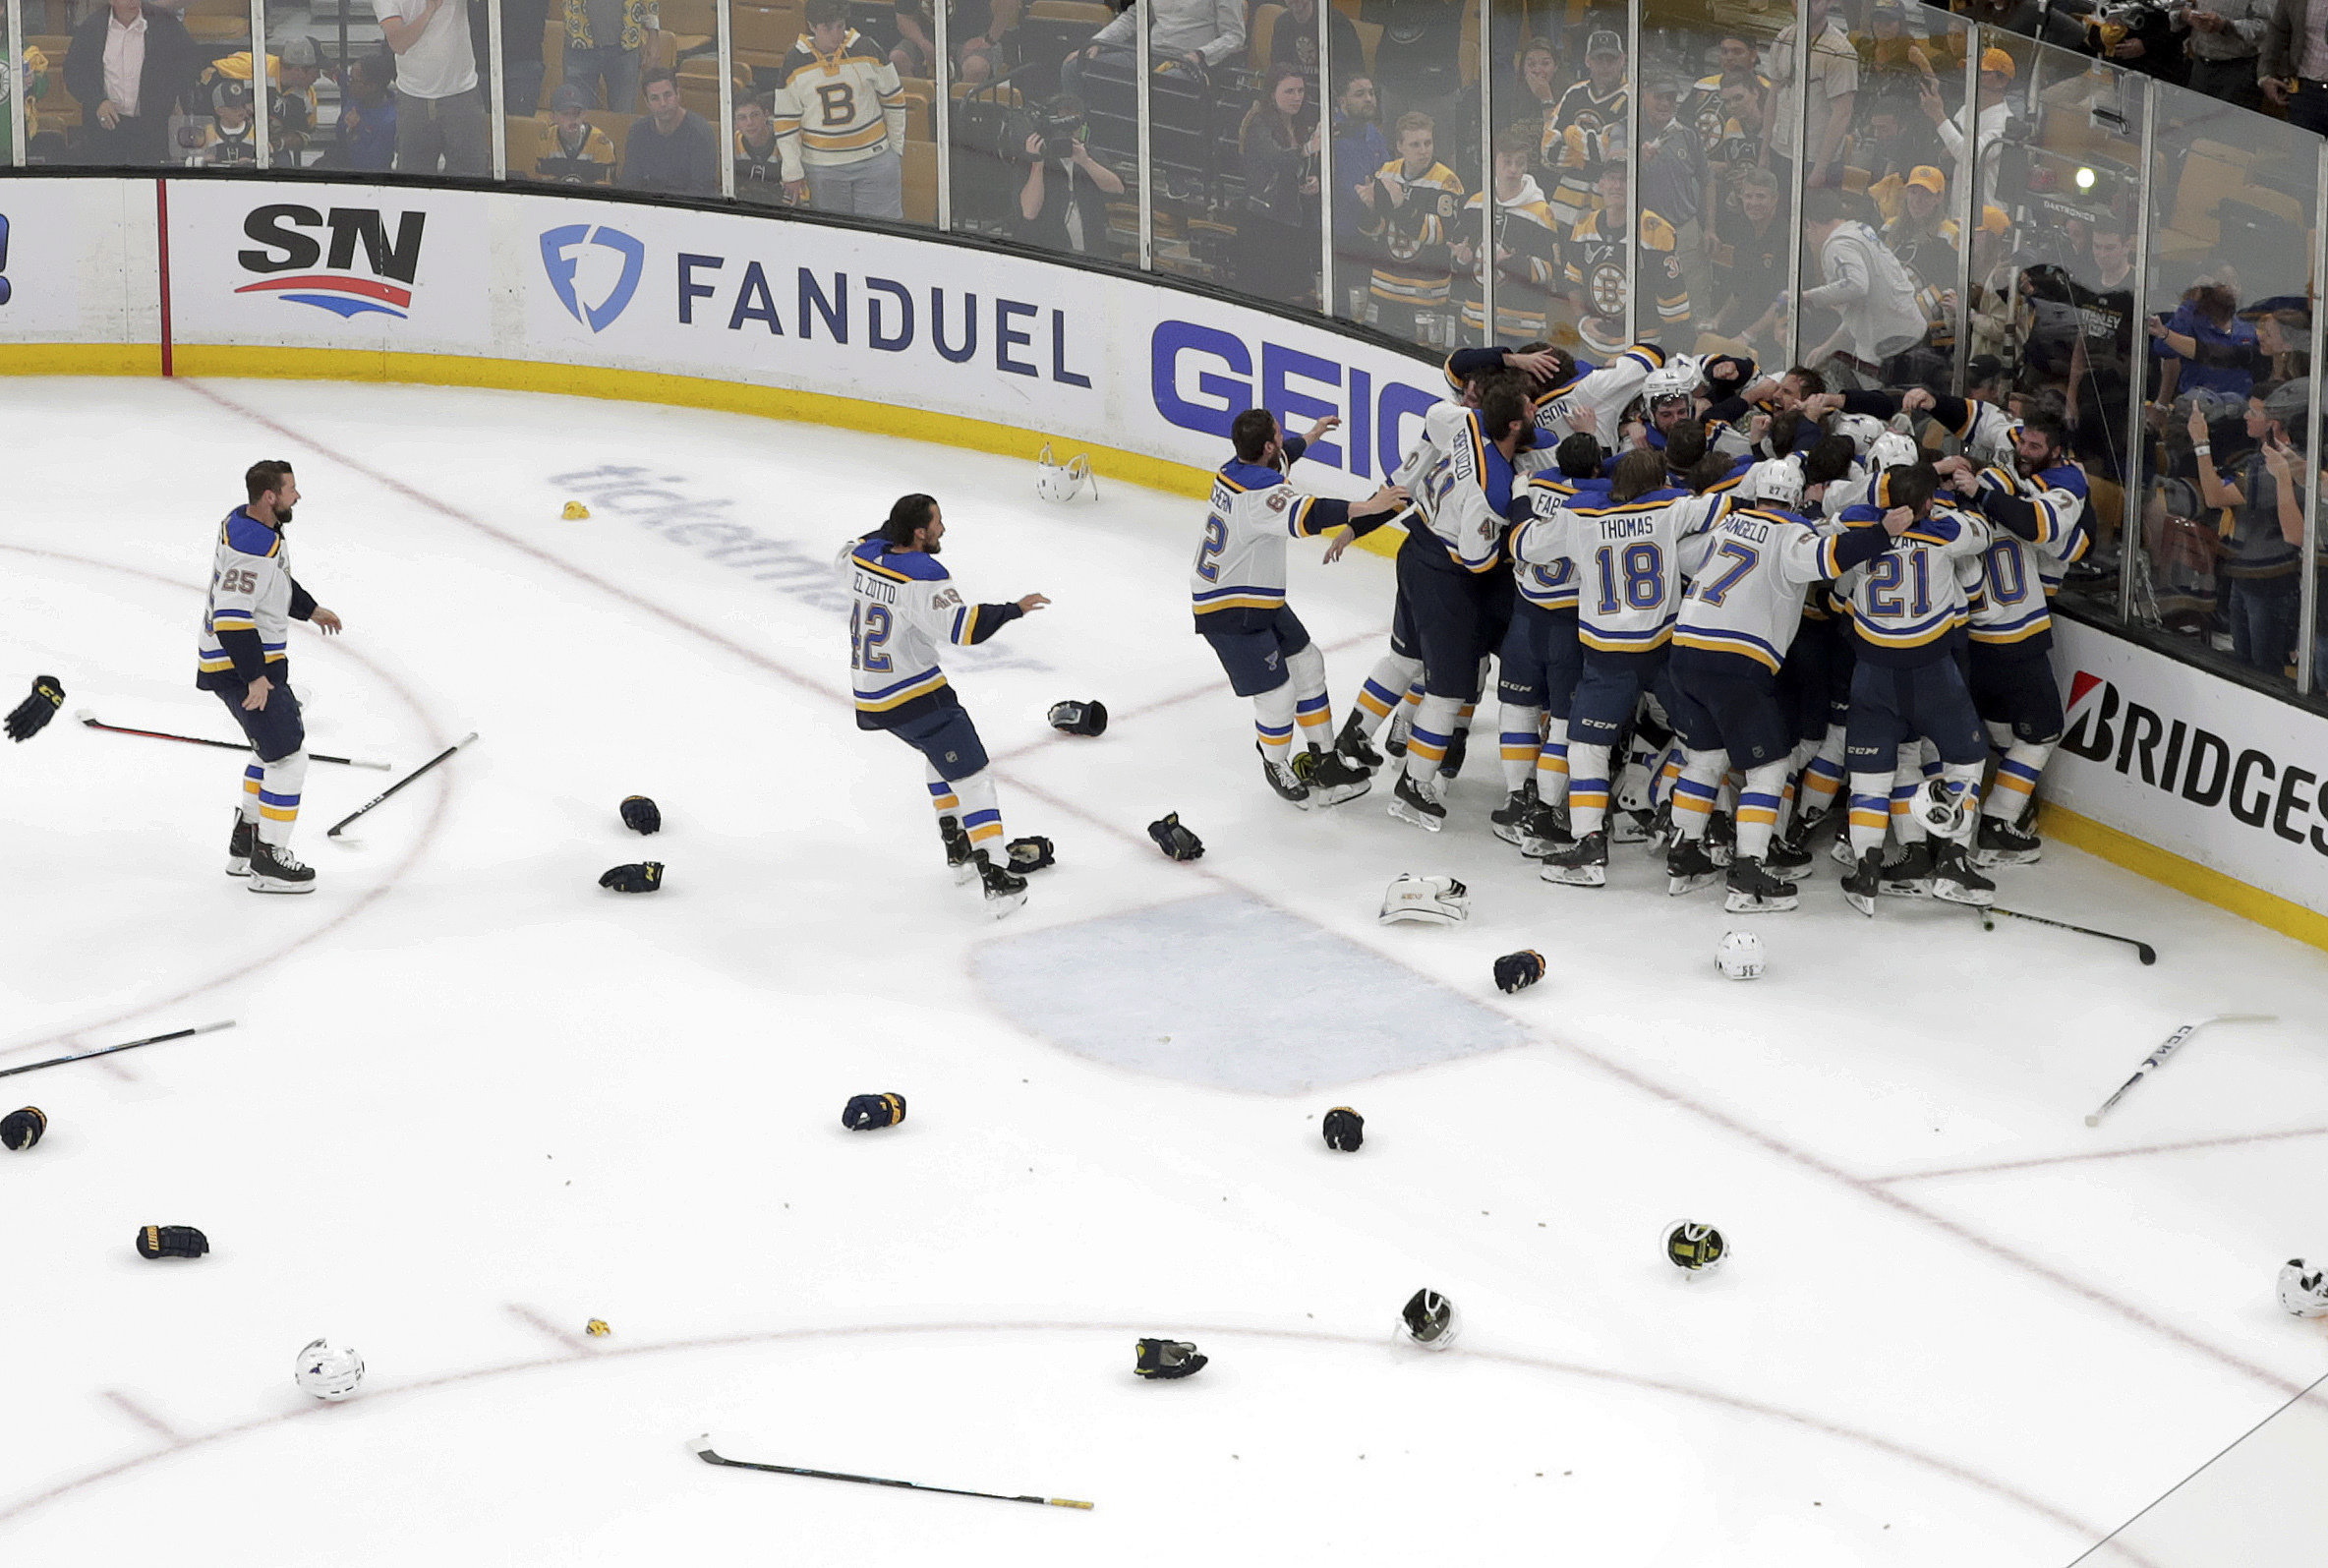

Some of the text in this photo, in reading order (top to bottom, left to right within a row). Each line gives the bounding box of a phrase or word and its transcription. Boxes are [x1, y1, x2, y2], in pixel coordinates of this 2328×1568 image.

[816, 82, 856, 127] B
[238, 203, 427, 285] SN
[677, 252, 1092, 390] FANDUEL
[1151, 319, 1443, 487] GEIC
[1193, 511, 1229, 585] 2
[1600, 515, 1655, 541] THOMAS
[1721, 516, 1770, 545] ANGELO
[221, 568, 259, 596] 25
[1595, 541, 1666, 616] 18
[1865, 548, 1933, 619] 21
[1581, 718, 1619, 730] CCM
[1847, 745, 1880, 756] CCM
